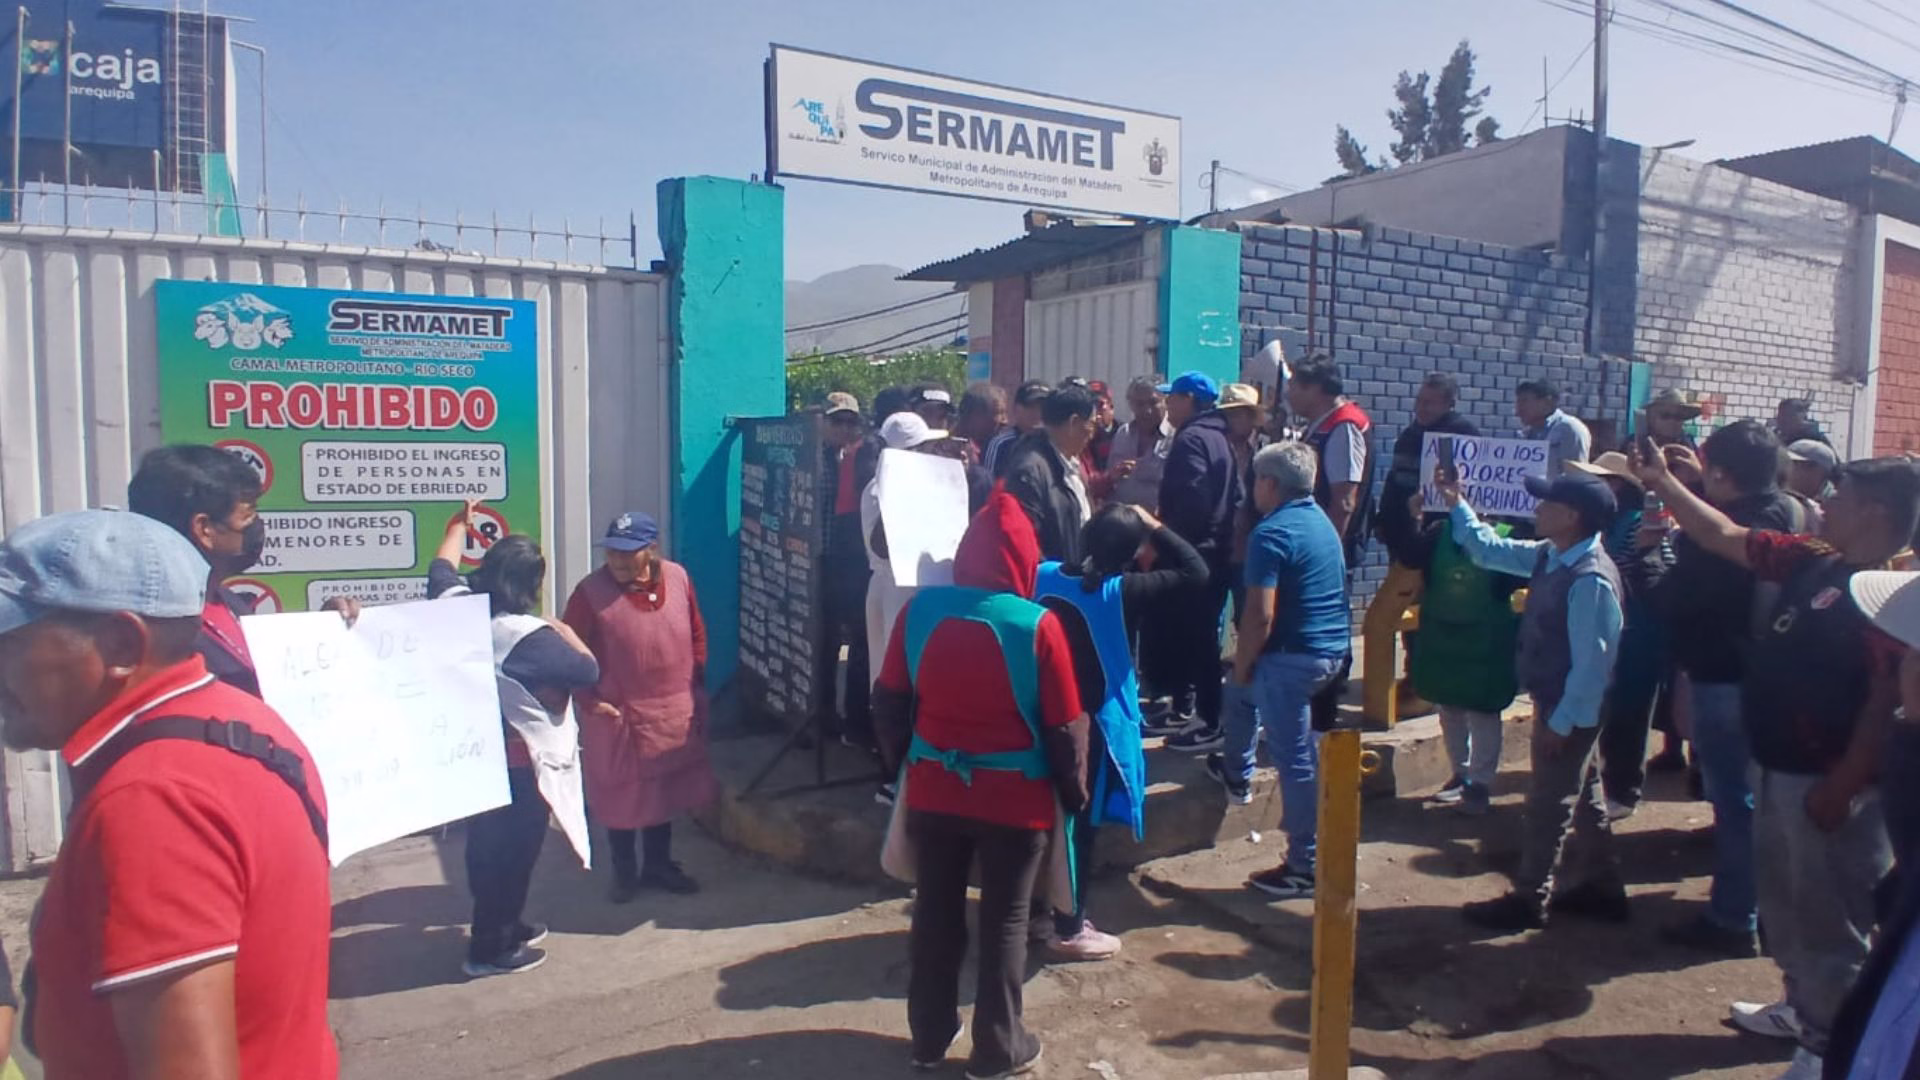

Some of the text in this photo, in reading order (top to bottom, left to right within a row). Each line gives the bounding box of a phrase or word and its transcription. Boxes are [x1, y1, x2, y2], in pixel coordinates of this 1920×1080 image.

[70, 48, 161, 90] caja
[70, 85, 136, 100] arequipa
[855, 78, 1125, 170] SERMAMET
[860, 147, 905, 163] Servico
[908, 153, 962, 171] Municipal
[964, 161, 979, 173] de
[1061, 175, 1076, 187] del
[1079, 178, 1123, 192] Matadero
[929, 171, 1068, 199] Metropolitano de Arequipa
[330, 300, 511, 338] SERMAMET
[231, 358, 280, 372] CAMAL
[286, 359, 405, 375] METROPOLITANO
[440, 365, 475, 377] SECO
[210, 381, 497, 429] PROHIBIDO
[316, 449, 407, 461] PROHIBIDO
[412, 449, 429, 461] EL
[433, 449, 500, 461] INGRESO
[318, 466, 500, 478] DE PERSONAS EN
[317, 483, 488, 495] ESTADO DE EBRIEDAD
[264, 516, 402, 530] HIBIDO INGRESO
[264, 534, 403, 548] MENORES DE
[322, 583, 407, 593] PROHIBIDO
[385, 593, 398, 601] DE
